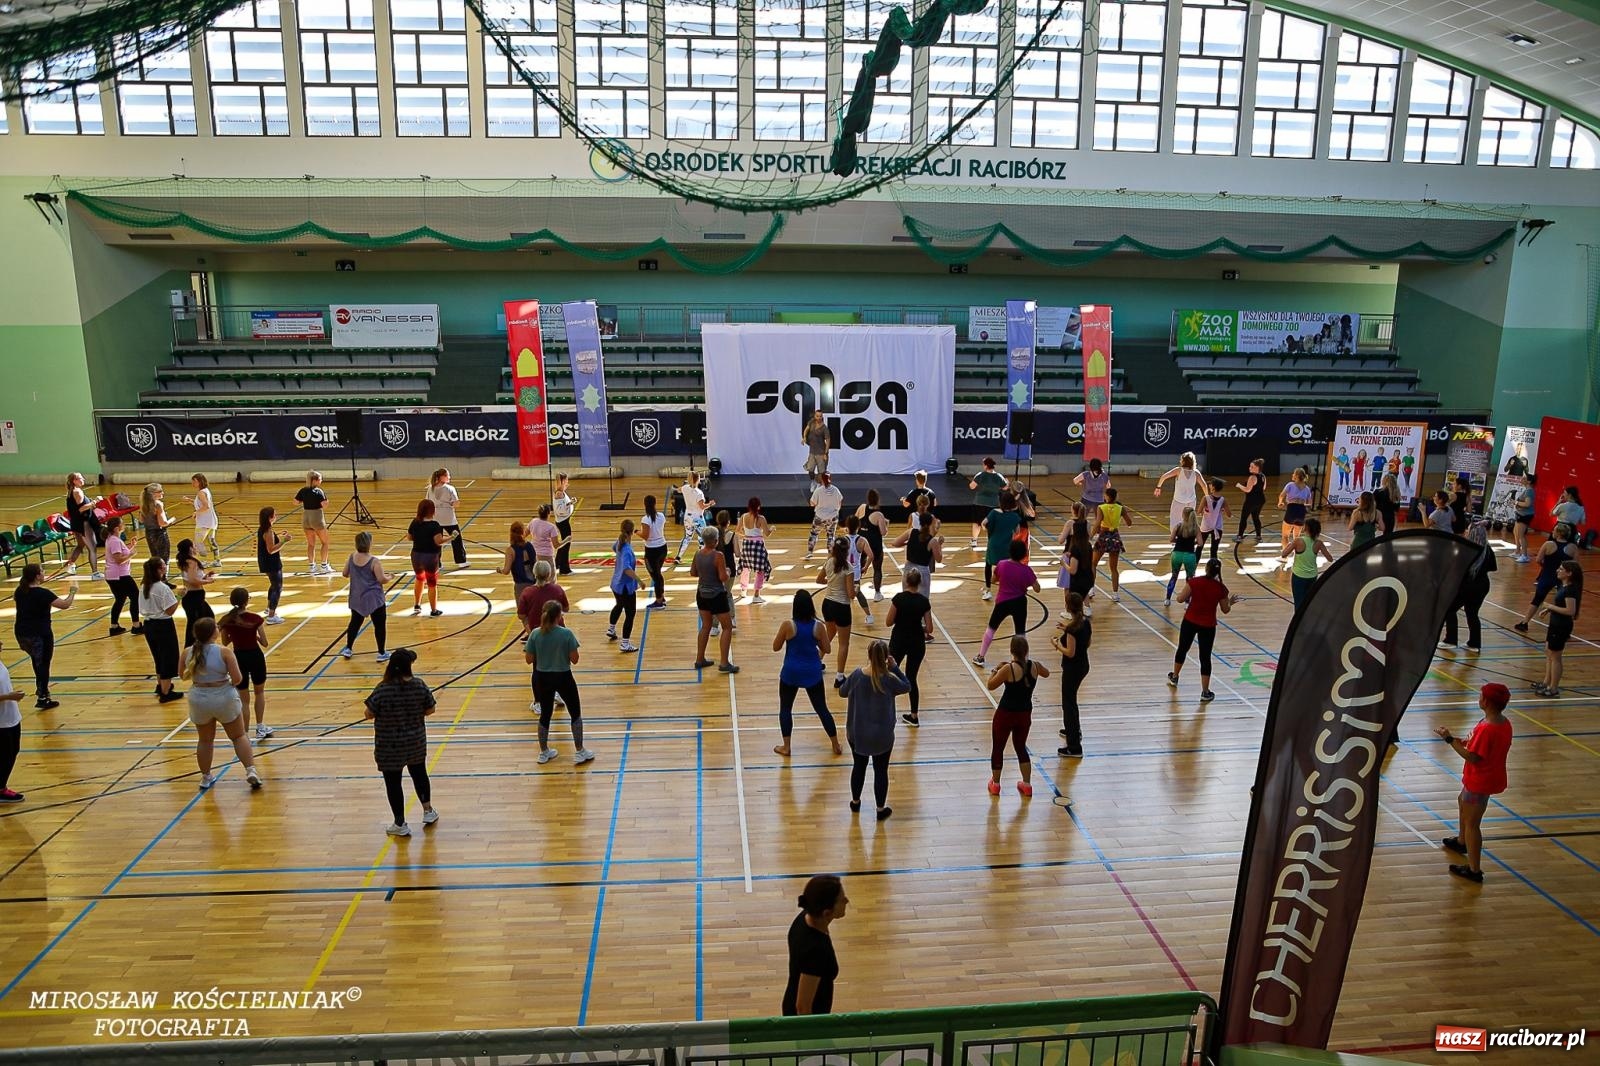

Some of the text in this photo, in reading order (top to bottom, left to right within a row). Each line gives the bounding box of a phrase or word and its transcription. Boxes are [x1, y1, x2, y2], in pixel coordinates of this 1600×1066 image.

[645, 149, 1066, 180] OŚRODEK SPORTU REKREACJI RACIBÓRZ
[975, 308, 1007, 317] MIESZK
[1242, 312, 1326, 322] WSZYSTKO DLA TWOJEGO
[353, 315, 434, 323] VANESSA
[1203, 314, 1233, 326] ZOO
[1200, 326, 1231, 336] MAR
[1242, 322, 1299, 331] DOMOWEGO ZOO
[425, 425, 509, 442] RACIBÓRZ
[548, 423, 579, 439] OSi
[955, 424, 1007, 439] RACIB
[1289, 423, 1313, 439] OS
[1346, 425, 1372, 434] DBAMY
[1379, 427, 1411, 436] ZDROWIE
[1453, 431, 1493, 441] NERF
[172, 429, 258, 446] RACIBÓRZ
[1350, 435, 1404, 446] FIZYCZNE DZIECI
